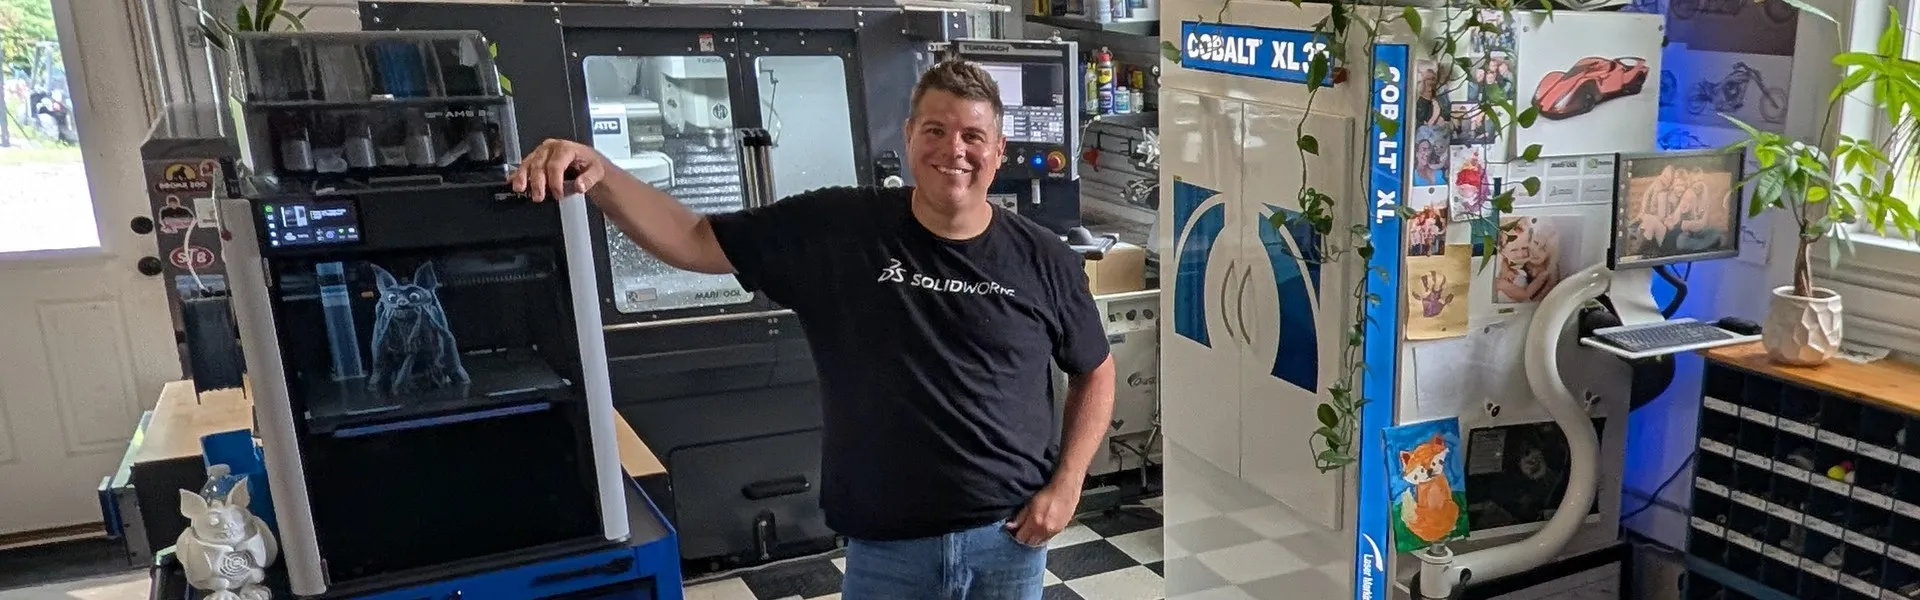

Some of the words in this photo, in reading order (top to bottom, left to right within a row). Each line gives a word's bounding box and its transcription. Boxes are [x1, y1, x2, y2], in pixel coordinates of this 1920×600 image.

[1187, 33, 1257, 66] COBALT
[594, 121, 618, 130] ATC
[1378, 66, 1400, 171] COBLT
[1376, 189, 1396, 224] XL
[177, 248, 207, 263] STB
